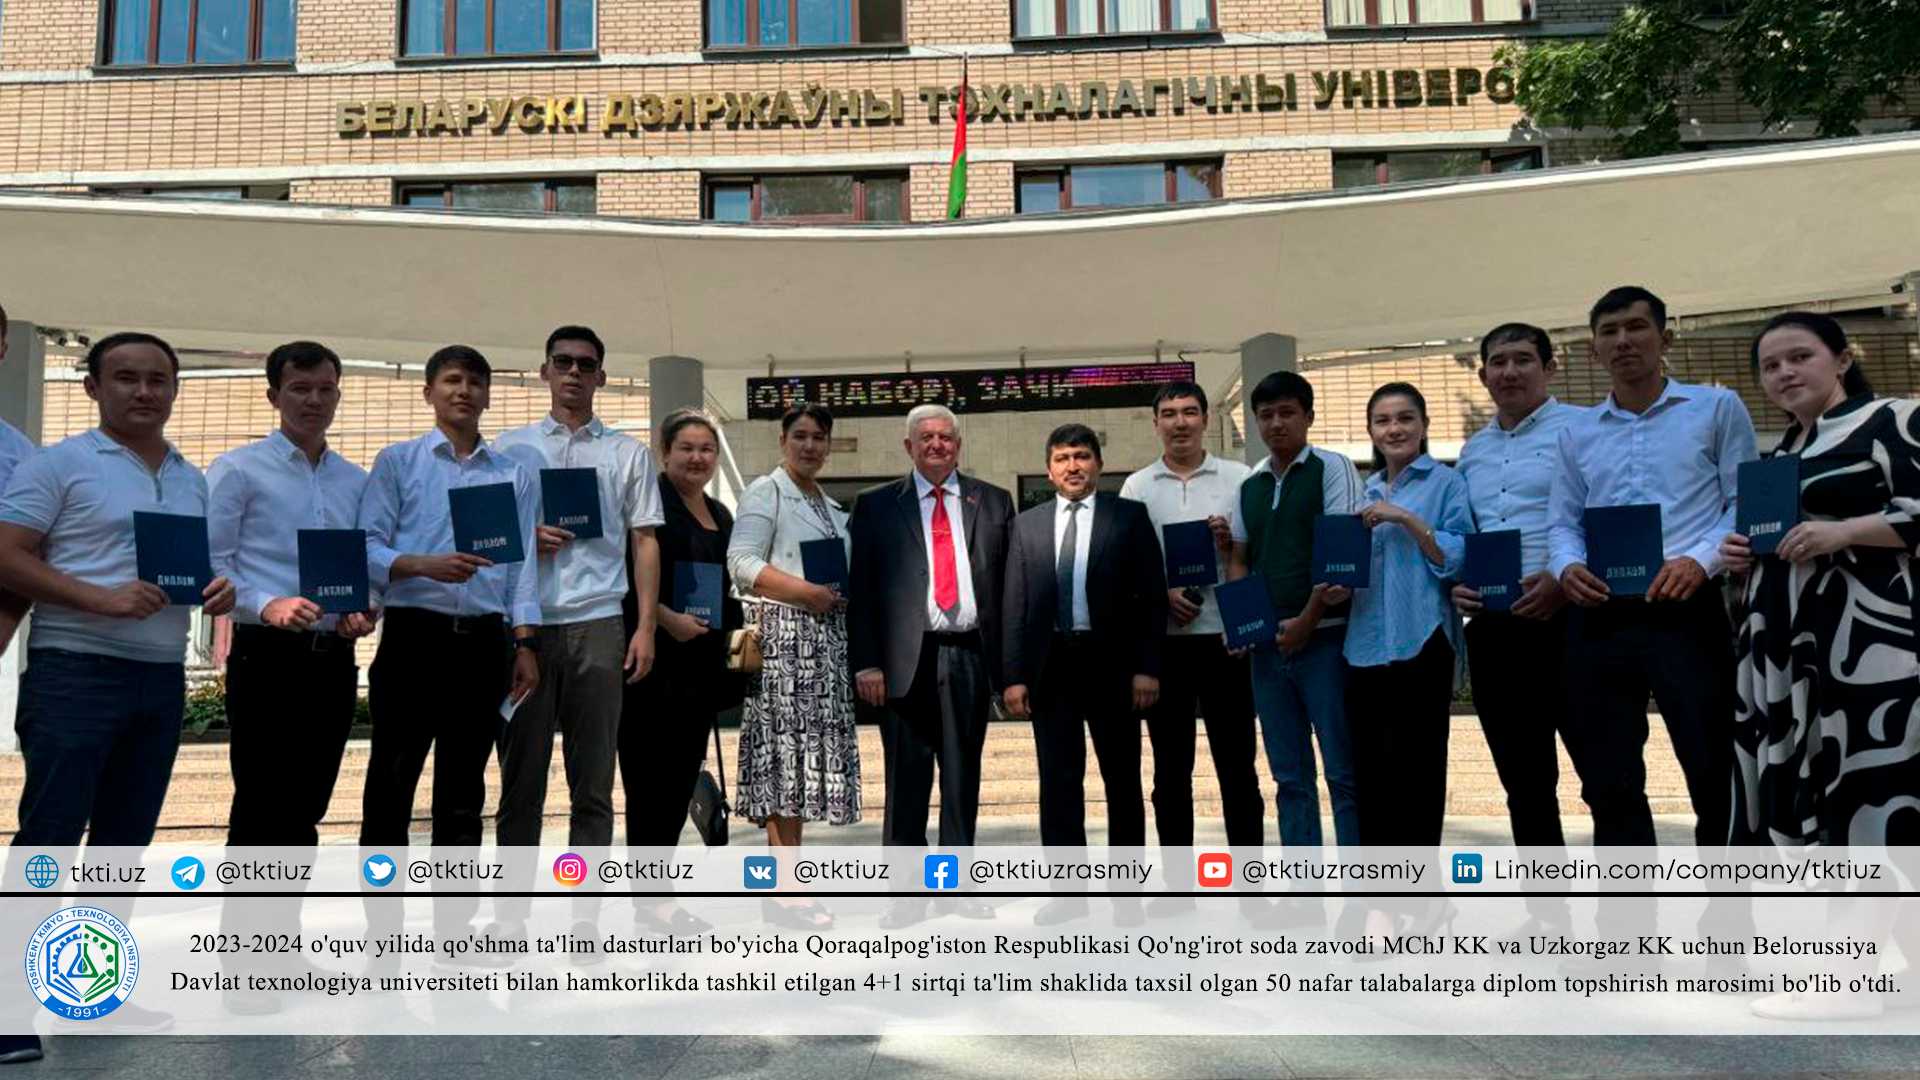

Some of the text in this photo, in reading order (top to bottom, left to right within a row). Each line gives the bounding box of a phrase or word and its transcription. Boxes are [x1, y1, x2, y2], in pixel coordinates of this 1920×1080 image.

[336, 95, 587, 137] БЕЛАРУСКІ
[601, 81, 903, 137] ДЗЯРЖАЎНЫ
[918, 73, 1298, 124] ТЭХНАЛАГІЧНЫ
[157, 575, 196, 587] ДИПЛОМ
